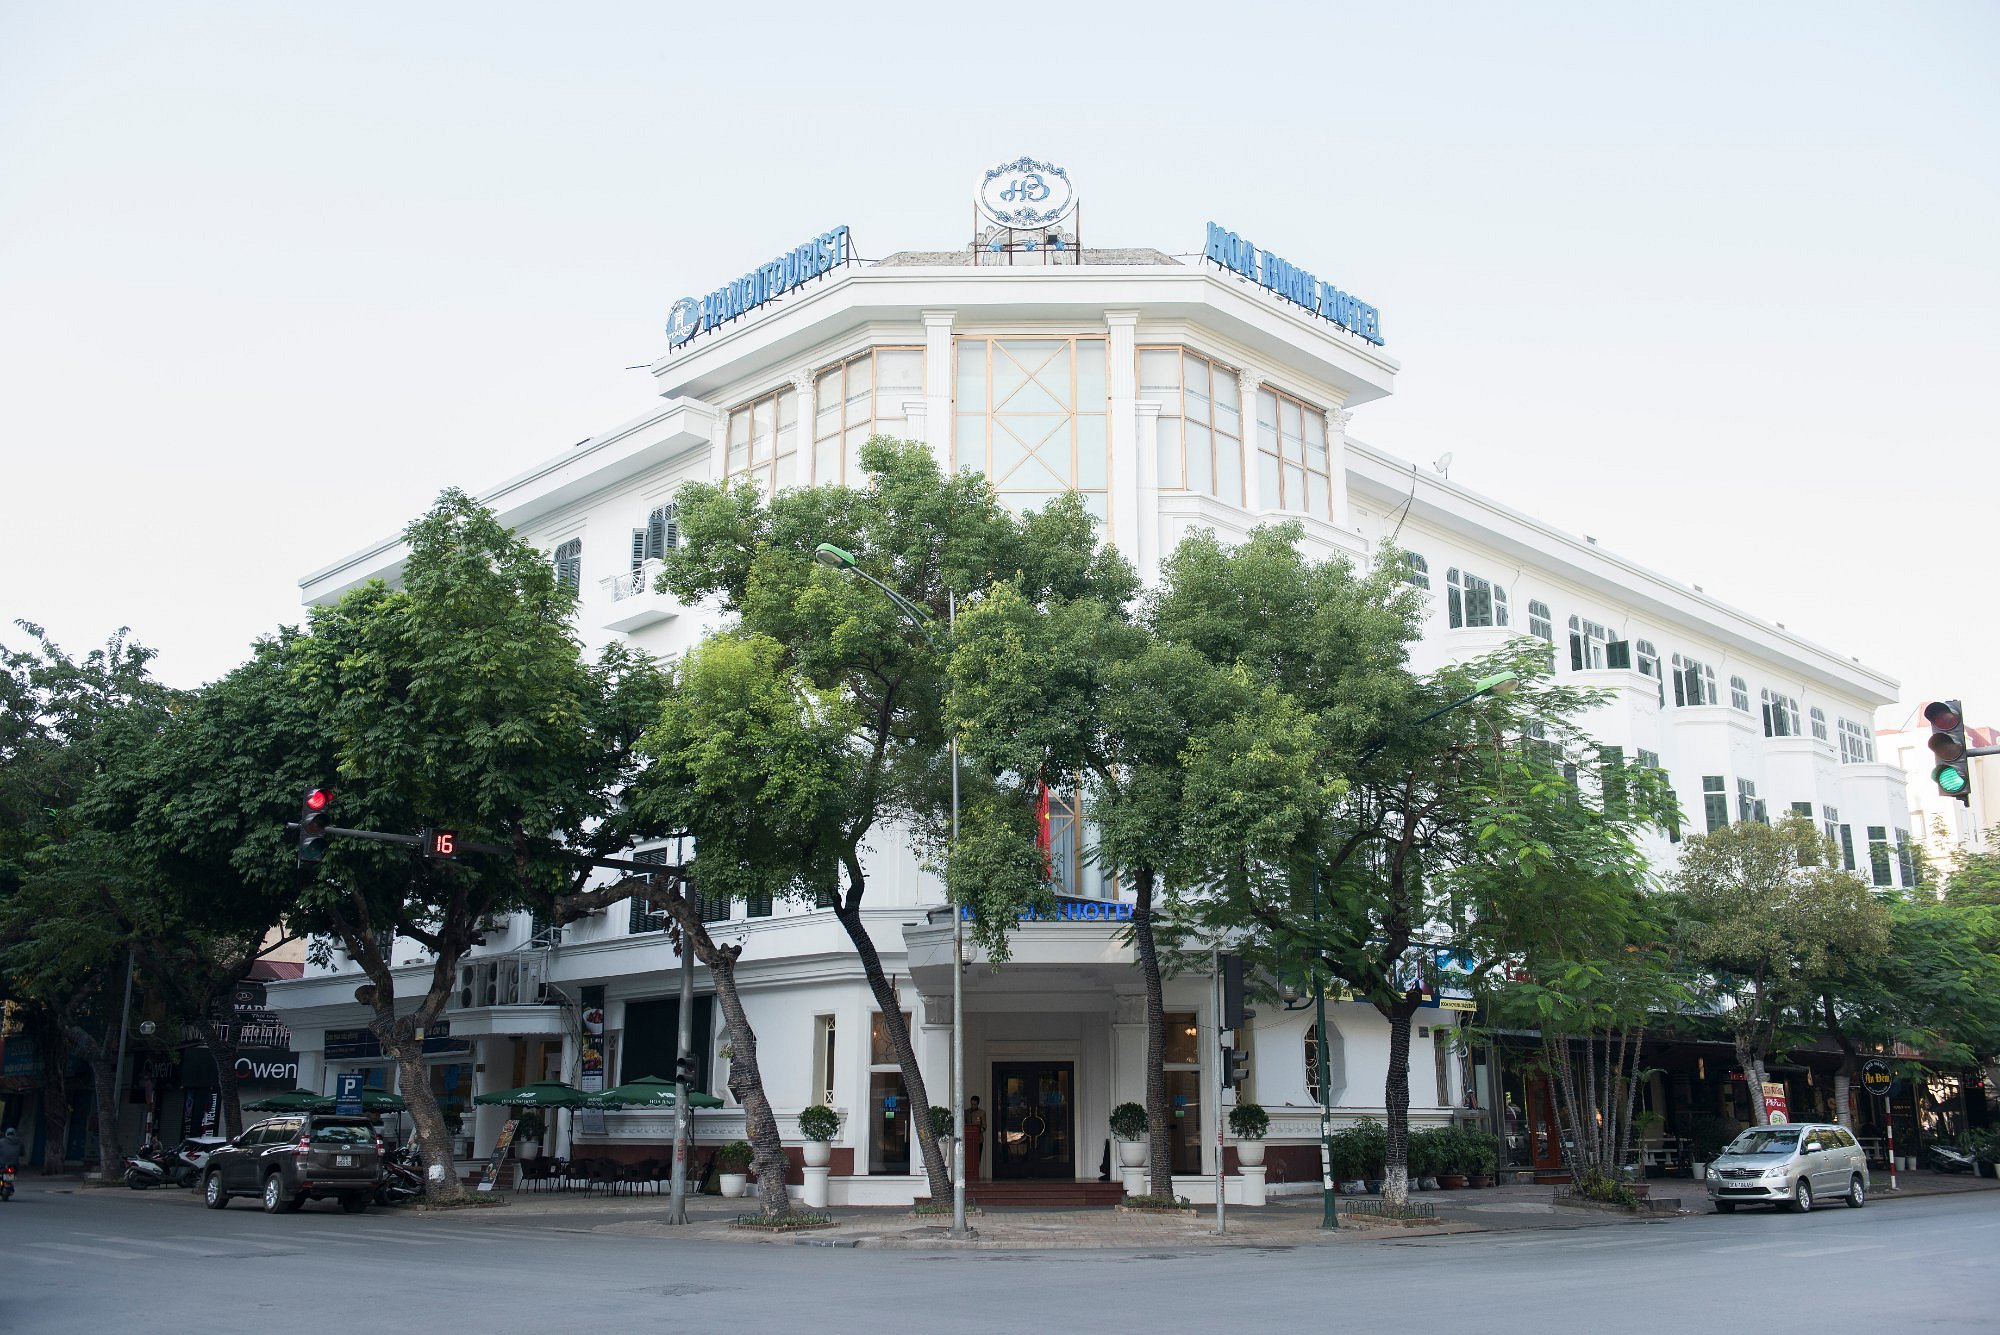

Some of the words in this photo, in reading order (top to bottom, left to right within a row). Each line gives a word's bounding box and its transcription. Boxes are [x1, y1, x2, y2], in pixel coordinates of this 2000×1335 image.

[702, 224, 848, 330] HANOITOURIST
[1321, 281, 1386, 347] HOTEL
[436, 834, 454, 854] 16
[234, 1057, 298, 1079] Owen
[344, 1079, 356, 1095] P
